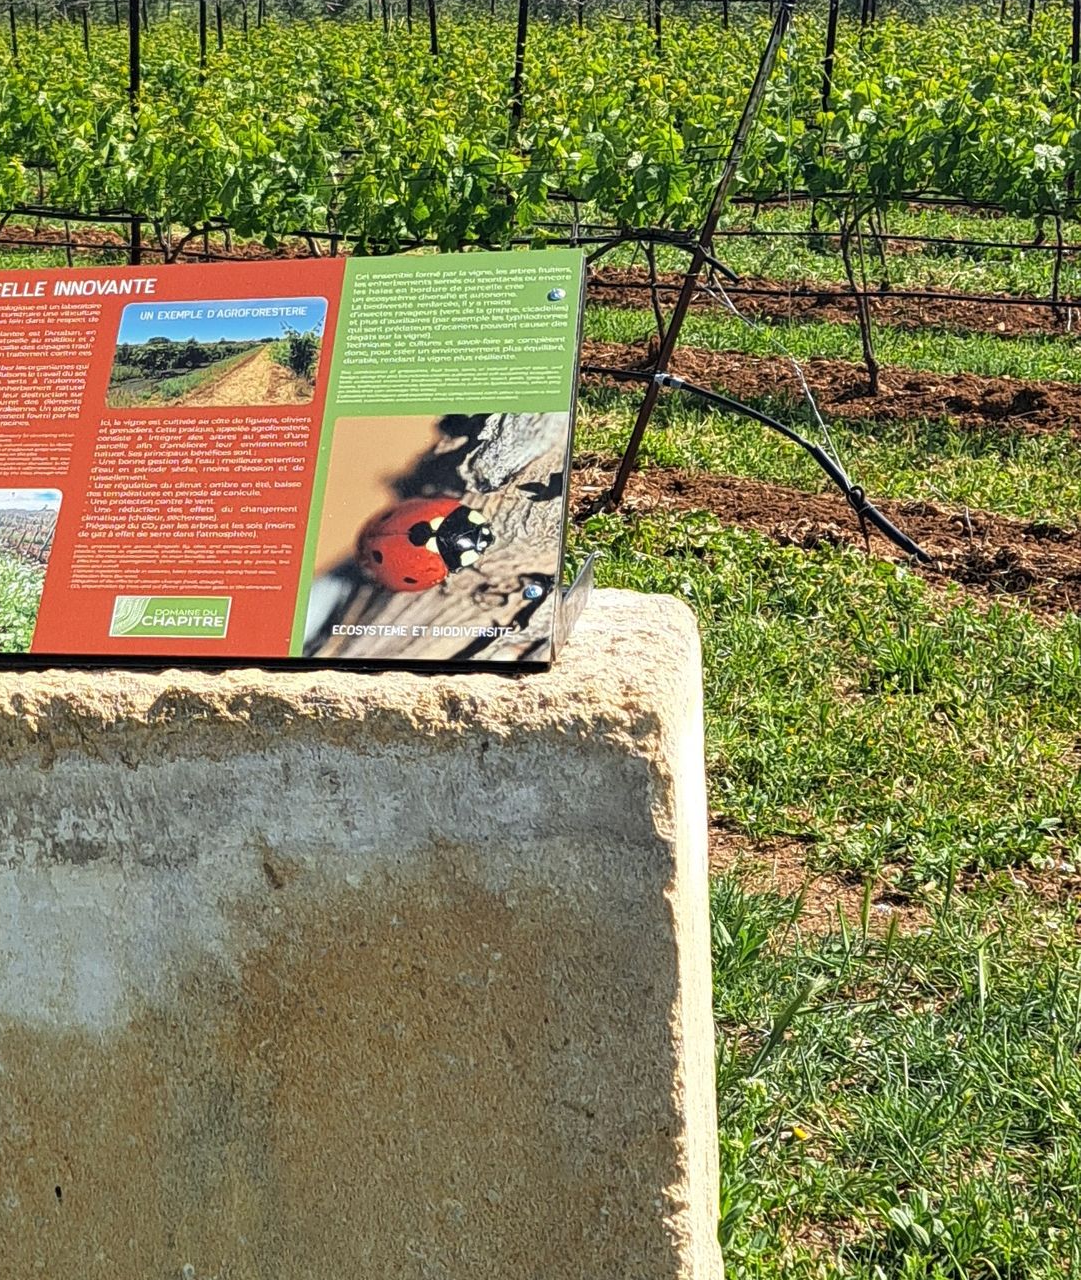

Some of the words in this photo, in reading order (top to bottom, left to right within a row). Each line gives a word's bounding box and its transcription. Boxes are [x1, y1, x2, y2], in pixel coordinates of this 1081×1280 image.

[53, 278, 158, 296] INNOVANTE
[140, 311, 154, 321] UN
[157, 310, 204, 320] EXEMPLE
[207, 306, 308, 319] D'AGROFORESTERIE
[155, 608, 201, 616] DOMAINE
[141, 615, 225, 627] CHAPITRE
[332, 624, 408, 636] ECOSYSTEME
[412, 625, 429, 637] ET
[432, 625, 514, 638] BIODIVERSITE
